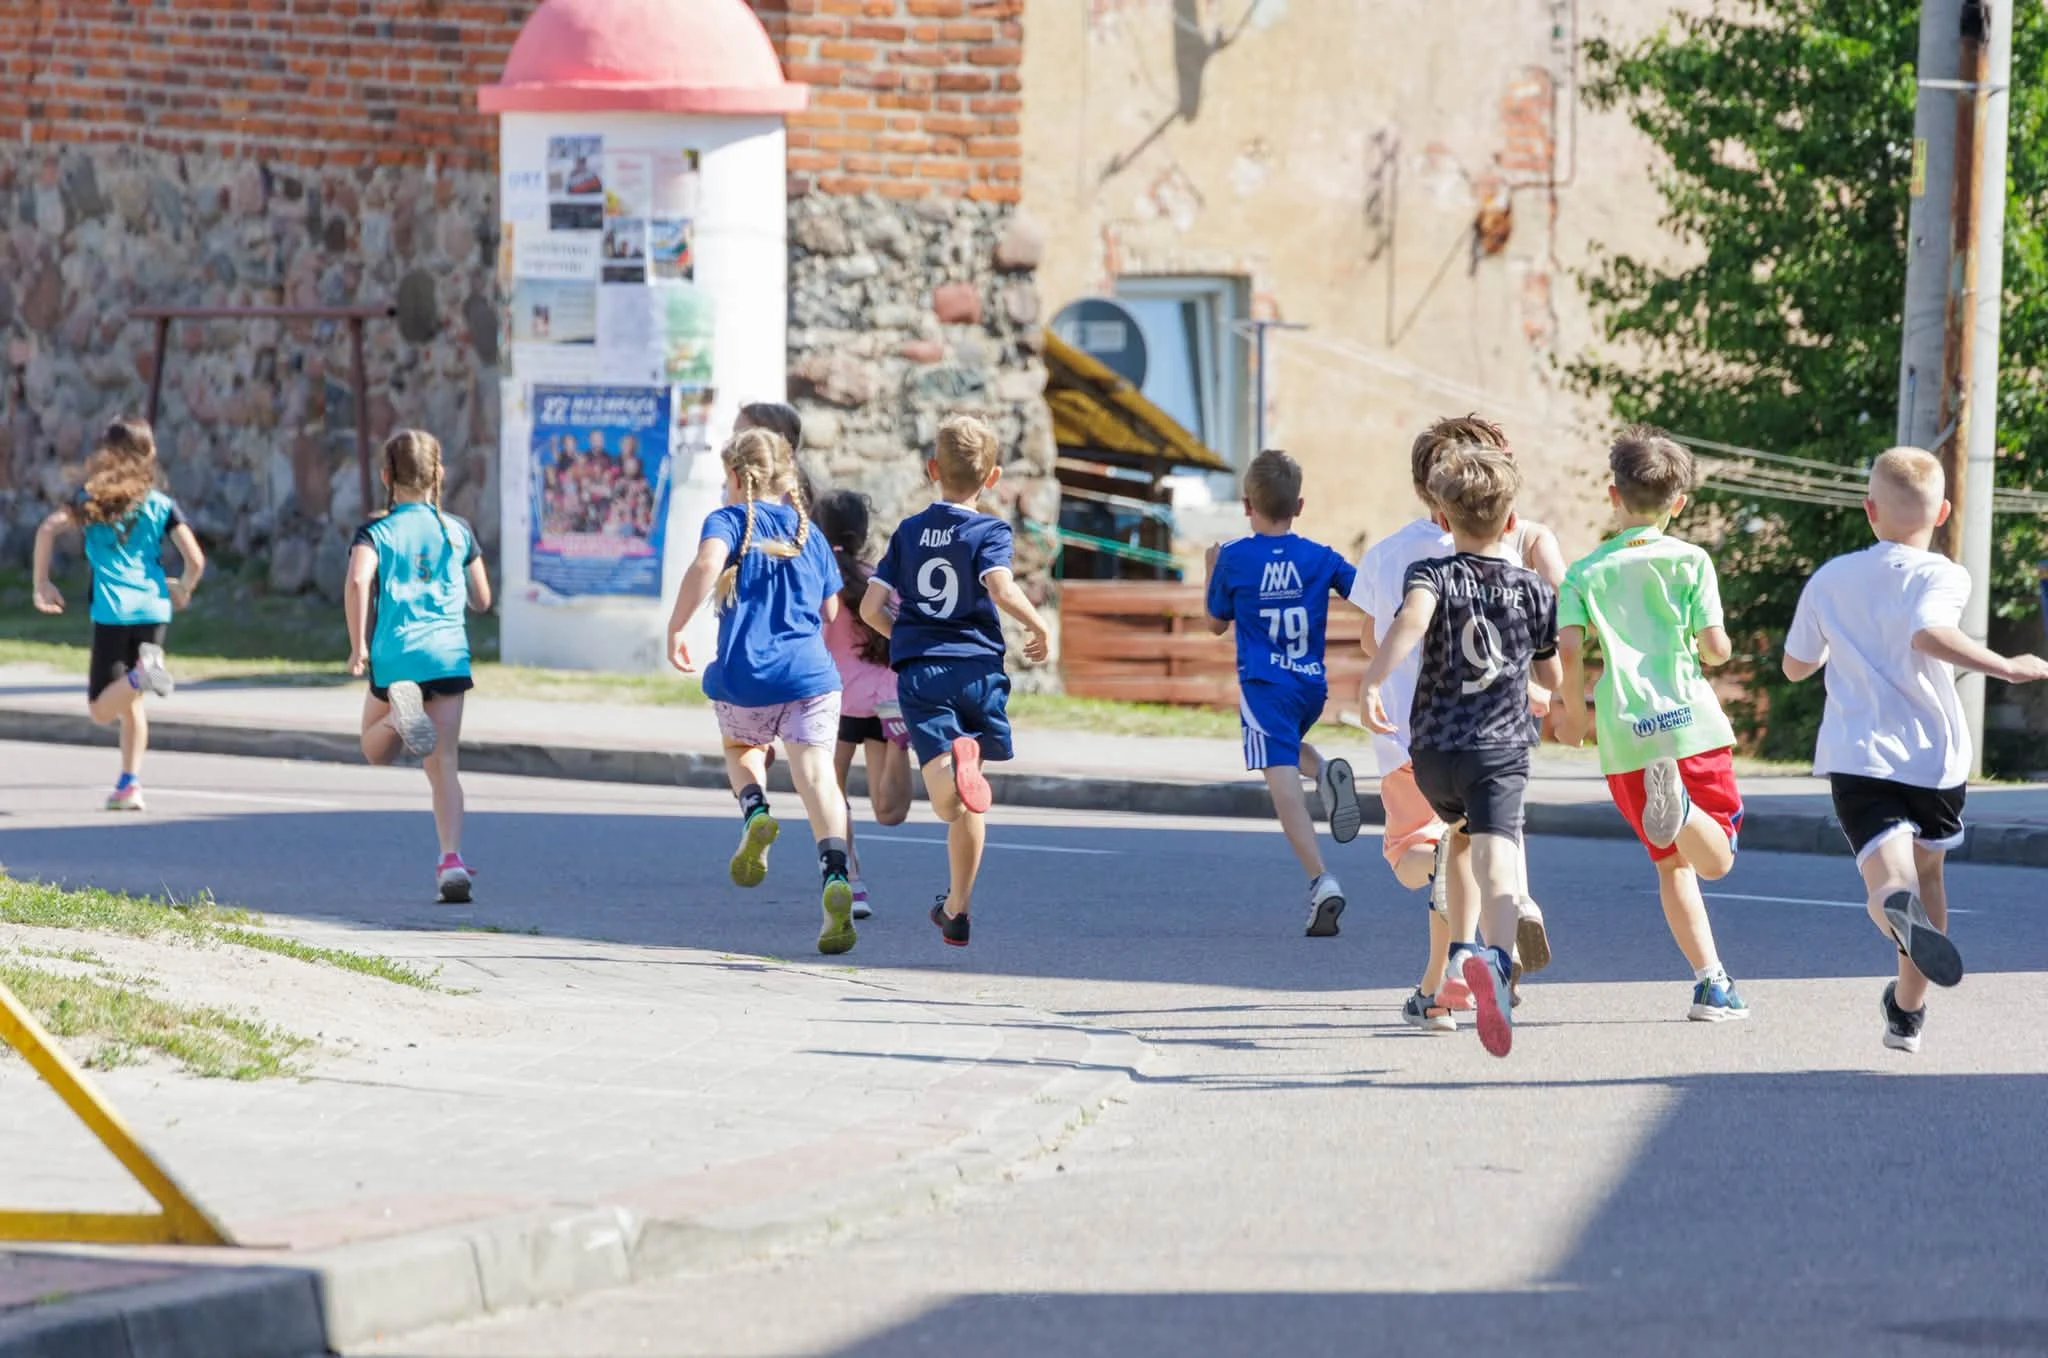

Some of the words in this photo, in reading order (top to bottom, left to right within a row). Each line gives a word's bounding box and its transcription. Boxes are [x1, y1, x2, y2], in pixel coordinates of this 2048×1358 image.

[917, 557, 959, 619] 9
[1259, 606, 1309, 659] 79
[1461, 616, 1504, 694] 9
[1656, 706, 1691, 722] UNHCR
[1659, 714, 1693, 730] ACNUR
